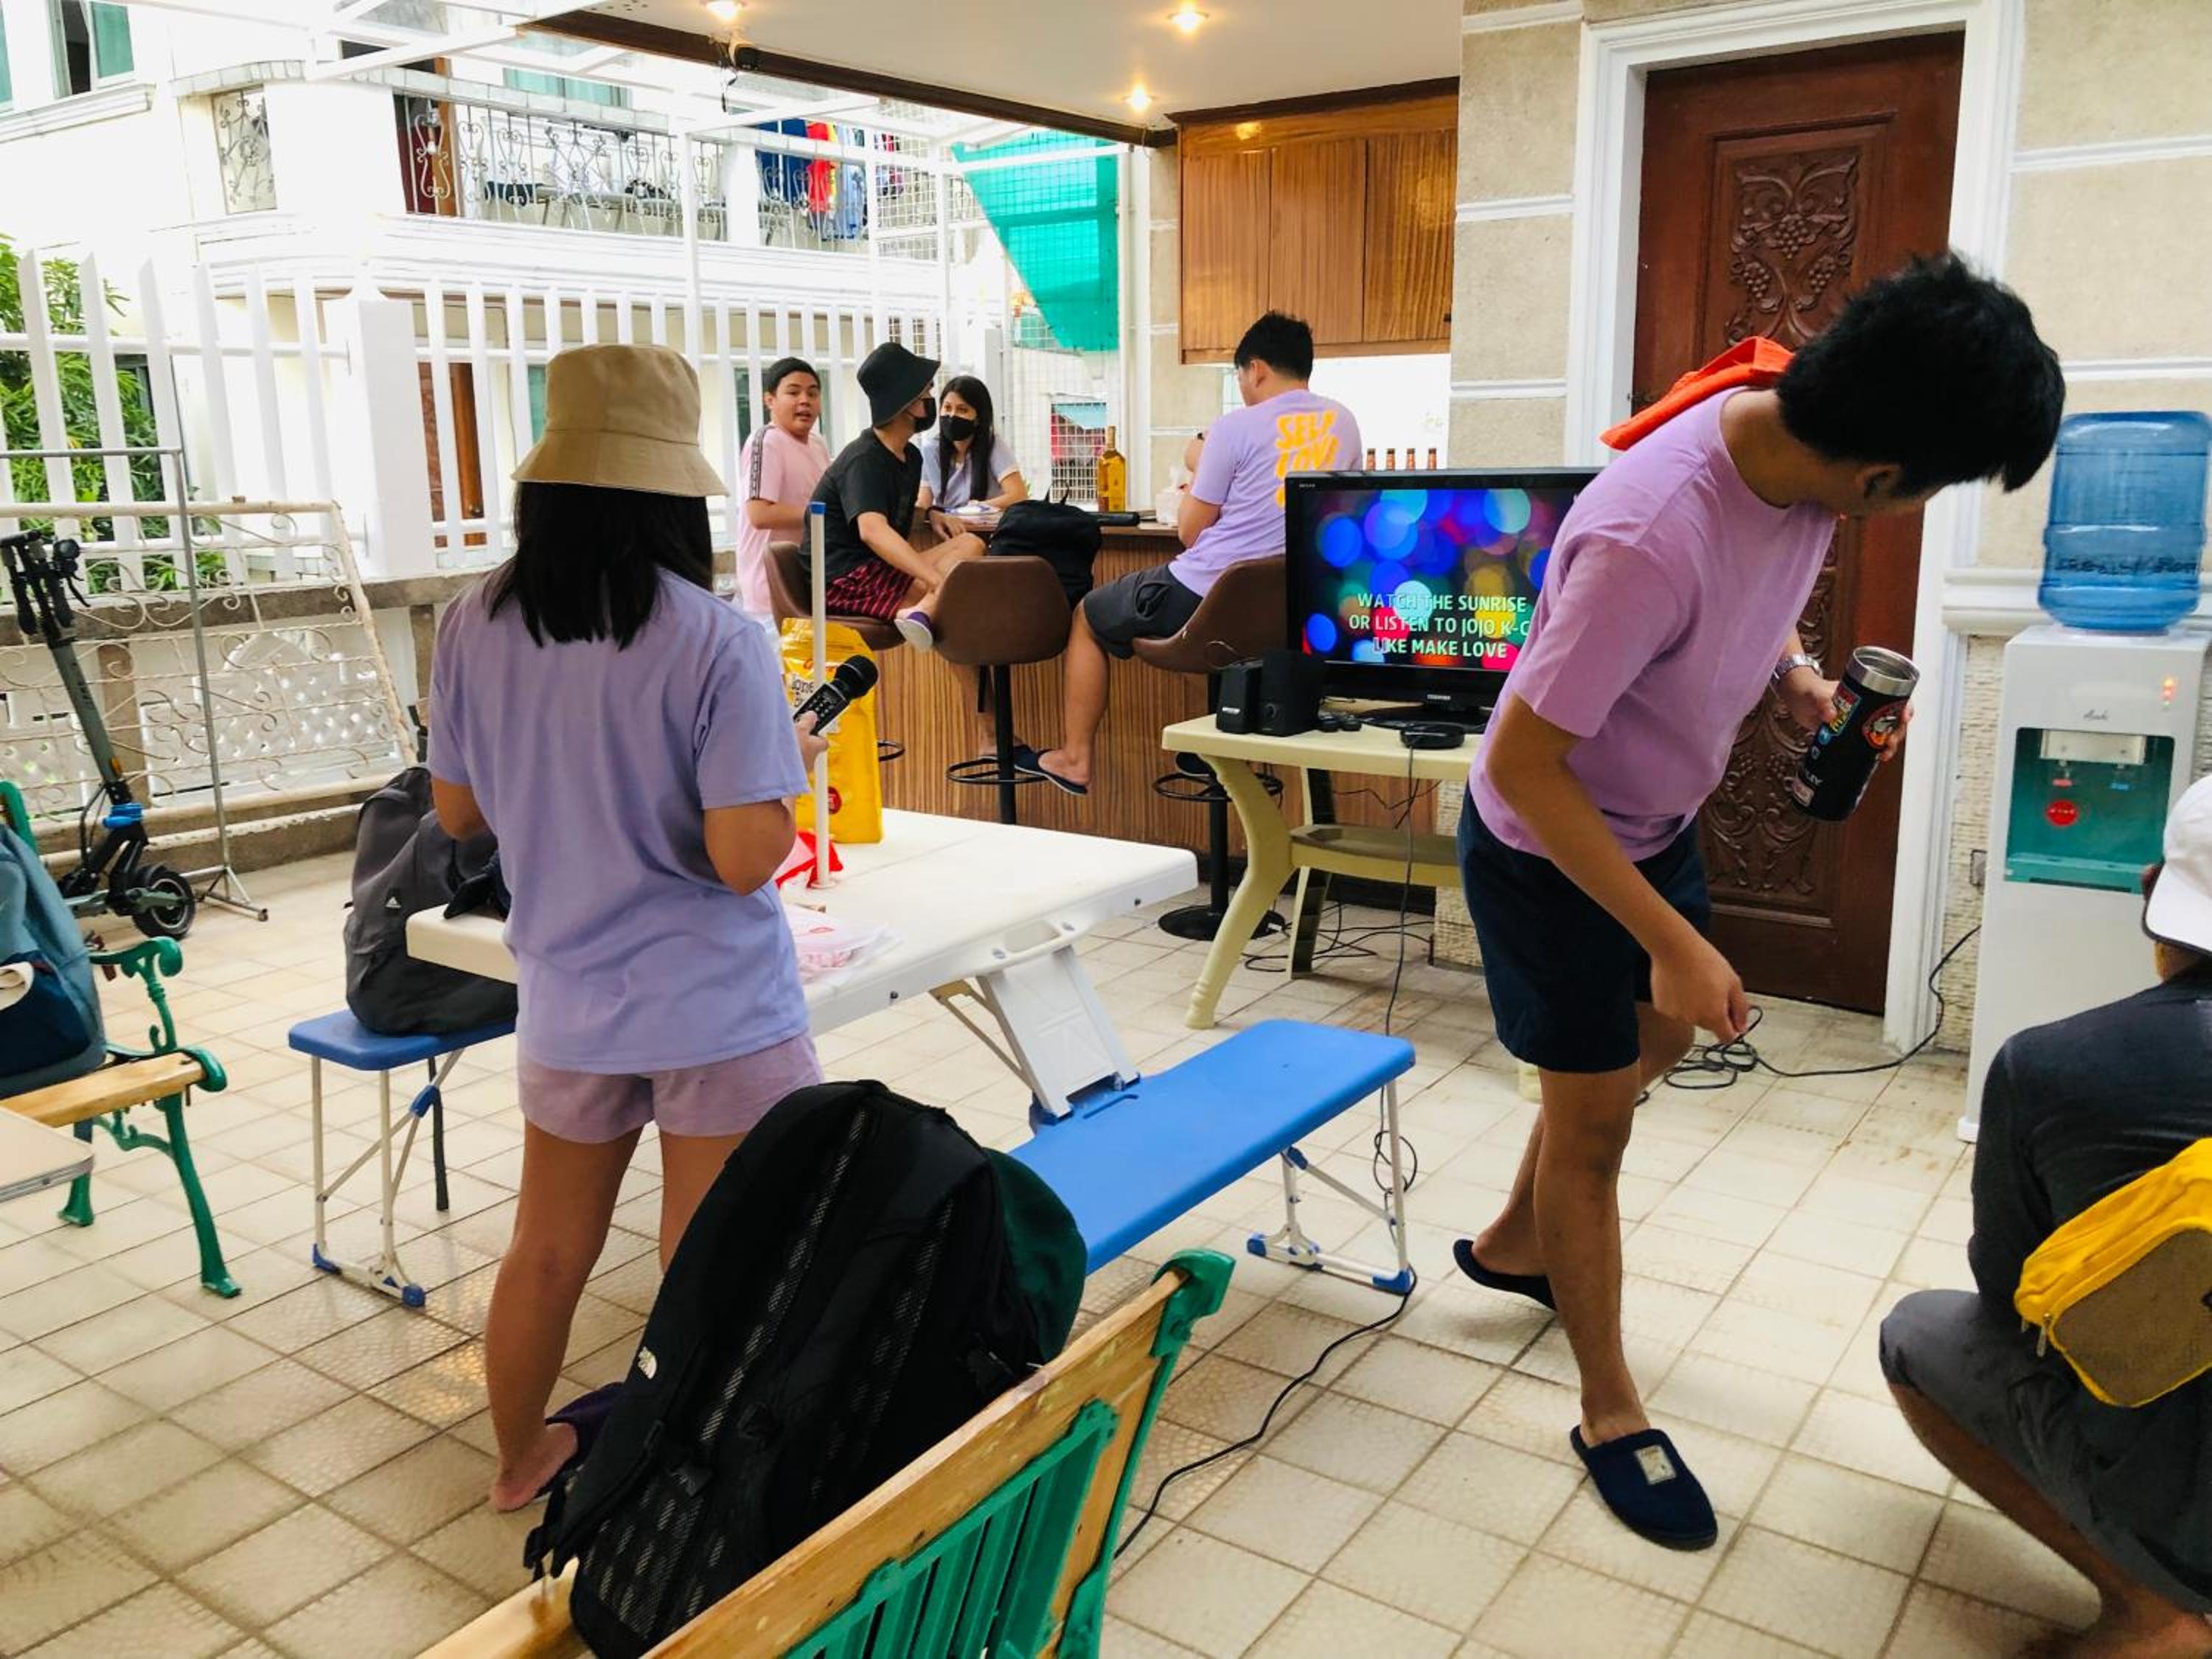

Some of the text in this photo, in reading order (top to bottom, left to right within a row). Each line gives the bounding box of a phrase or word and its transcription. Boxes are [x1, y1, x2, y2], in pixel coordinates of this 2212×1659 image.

[1357, 593, 1527, 613] WATCH THE SUNRISE
[1349, 614, 1370, 630] OR
[1374, 616, 1429, 632] LISTEN
[1435, 617, 1457, 633] TO
[1372, 637, 1508, 658] LIKE MAKE LOVE
